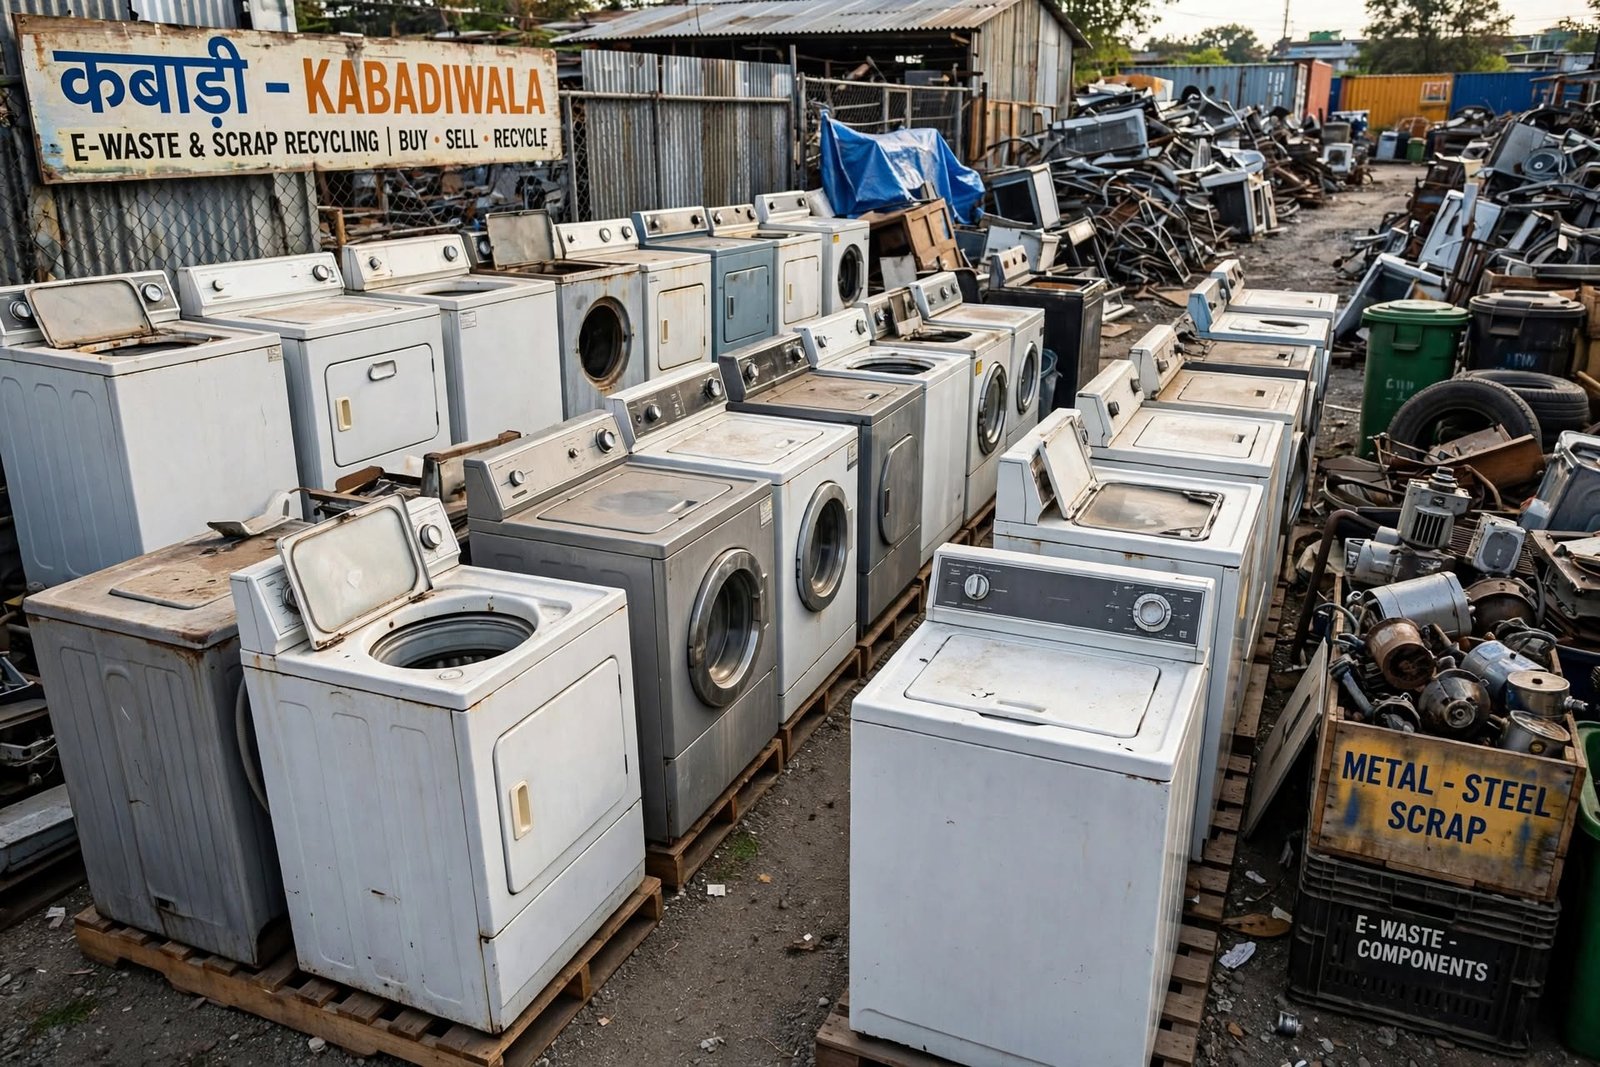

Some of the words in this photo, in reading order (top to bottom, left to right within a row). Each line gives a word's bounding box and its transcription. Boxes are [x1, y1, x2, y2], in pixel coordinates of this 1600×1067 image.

[52, 36, 249, 129] कबाड़ी
[302, 57, 546, 115] KABADIWALA
[71, 132, 179, 162] E-WASTE
[189, 131, 205, 158] &
[212, 130, 278, 158] SCRAP
[284, 129, 379, 155] RECYCLING
[399, 129, 428, 151] BUY
[446, 128, 478, 150] SELL
[494, 127, 548, 149] RECYCLE
[1341, 750, 1434, 796] METAL
[1462, 773, 1551, 818] STEEL
[1387, 801, 1487, 845] SCRAP
[1355, 914, 1445, 950] E-WASTE
[1357, 939, 1489, 982] COMPONENTS
